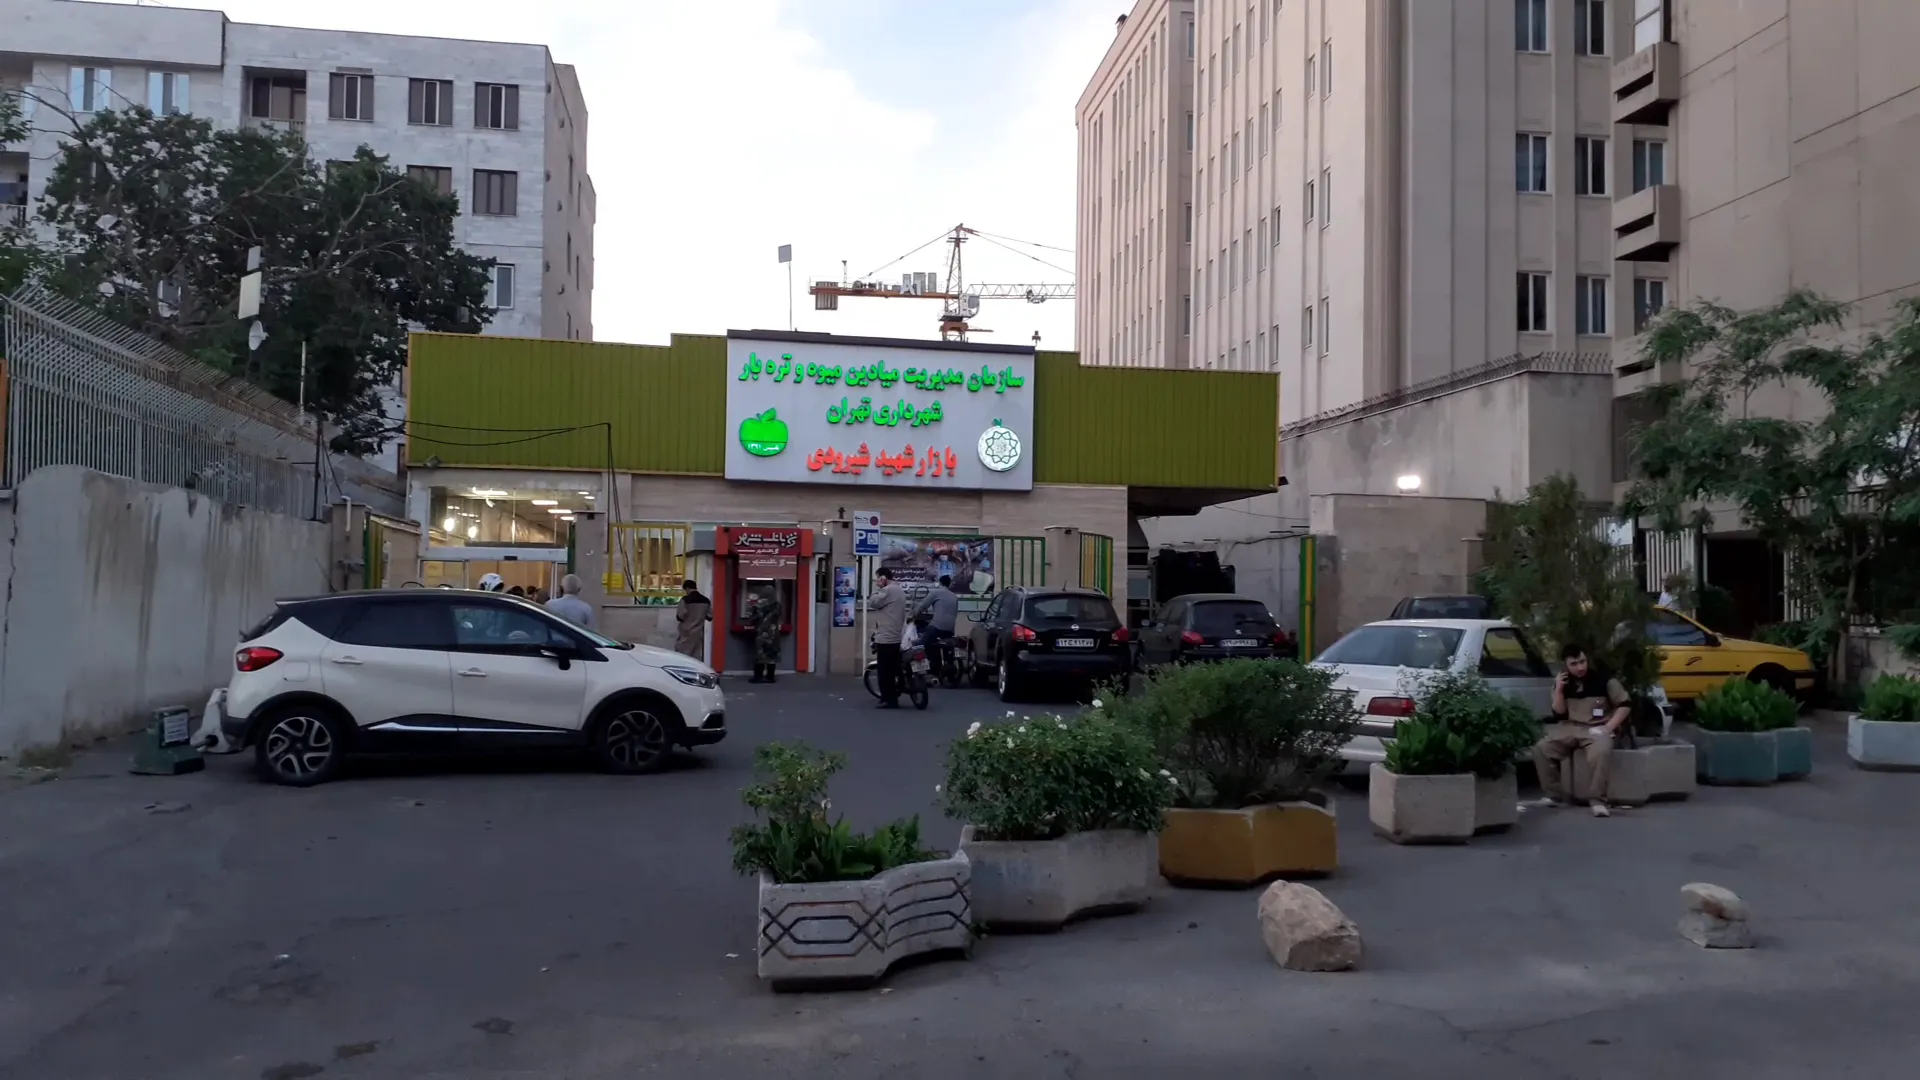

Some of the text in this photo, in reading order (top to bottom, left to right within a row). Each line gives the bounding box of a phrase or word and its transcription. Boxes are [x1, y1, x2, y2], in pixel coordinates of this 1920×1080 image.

[738, 352, 1025, 394] سازمان مدیریت میادین میوه و تره بار
[826, 396, 944, 427] شهرداری تهران
[807, 442, 957, 477] بازار شهید شیرودی
[735, 531, 787, 547] بانک شهر
[856, 530, 867, 545] P
